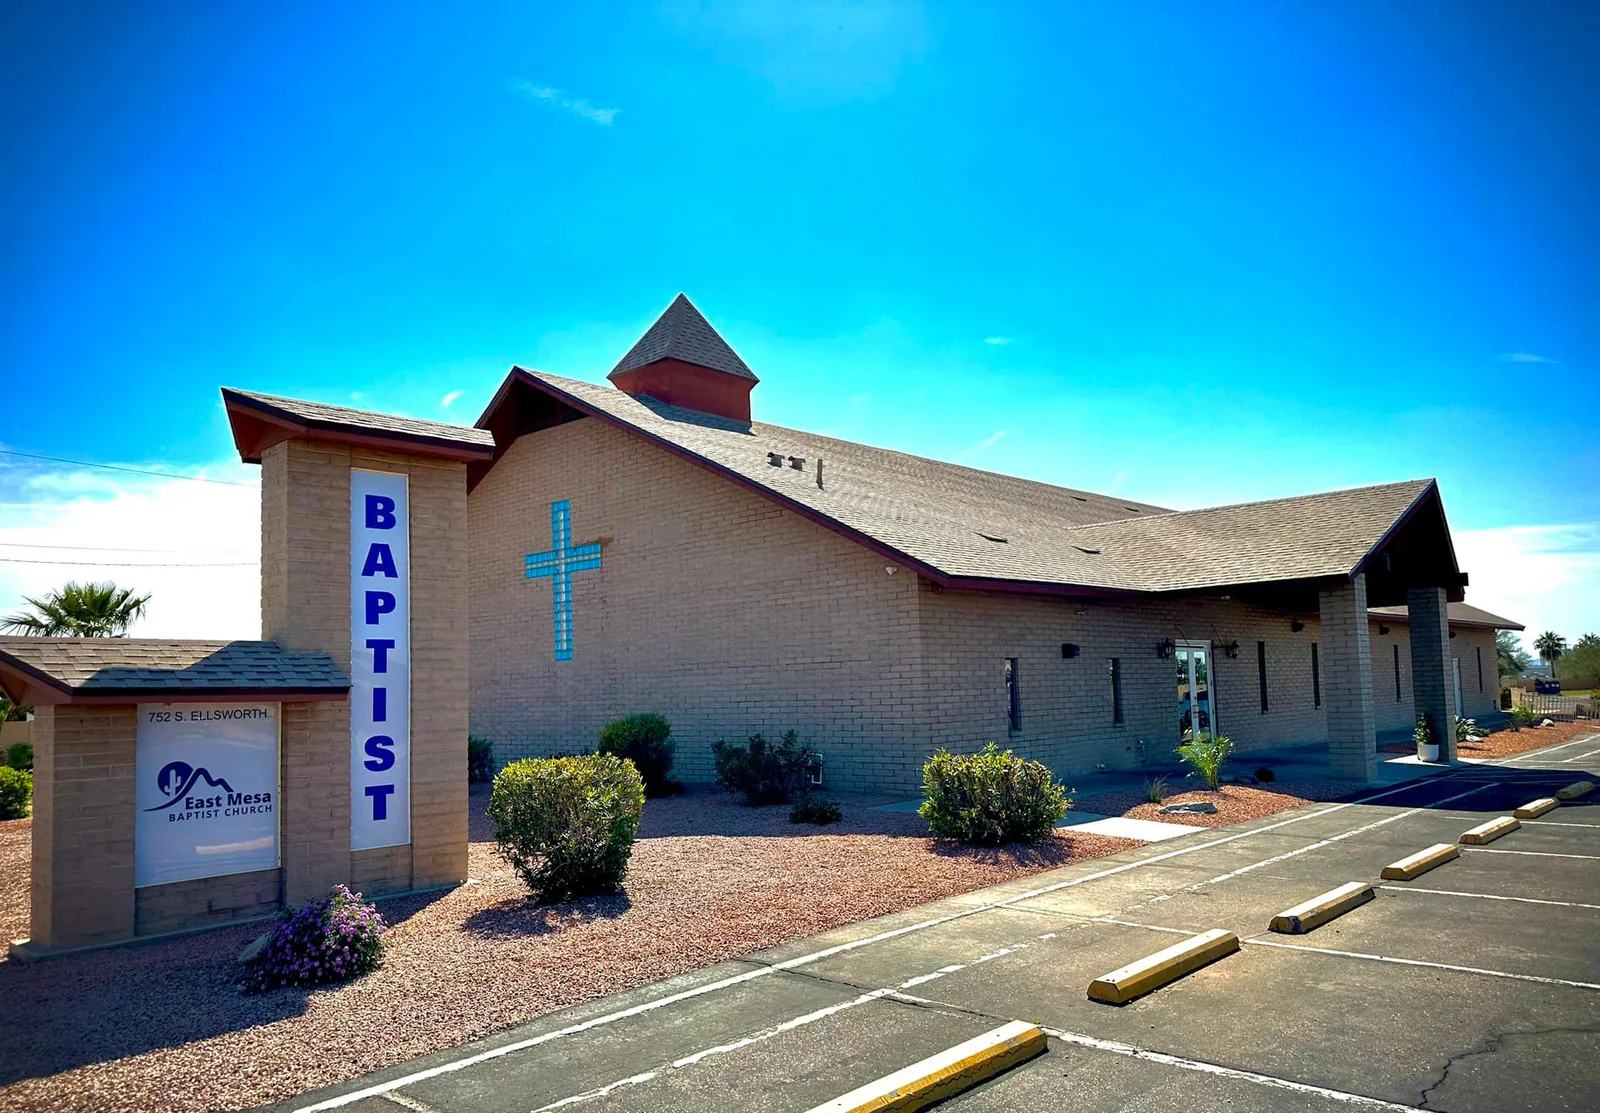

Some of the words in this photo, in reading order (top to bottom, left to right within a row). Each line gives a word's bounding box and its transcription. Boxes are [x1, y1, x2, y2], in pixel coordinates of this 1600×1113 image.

[361, 494, 399, 821] BAPTIST
[149, 712, 171, 723] 752
[174, 711, 187, 722] S.
[191, 709, 267, 721] ELLSWORTH
[185, 794, 222, 810] East
[227, 792, 272, 806] Mesa
[169, 809, 220, 822] BAPTIST
[224, 804, 272, 816] CHURCH
